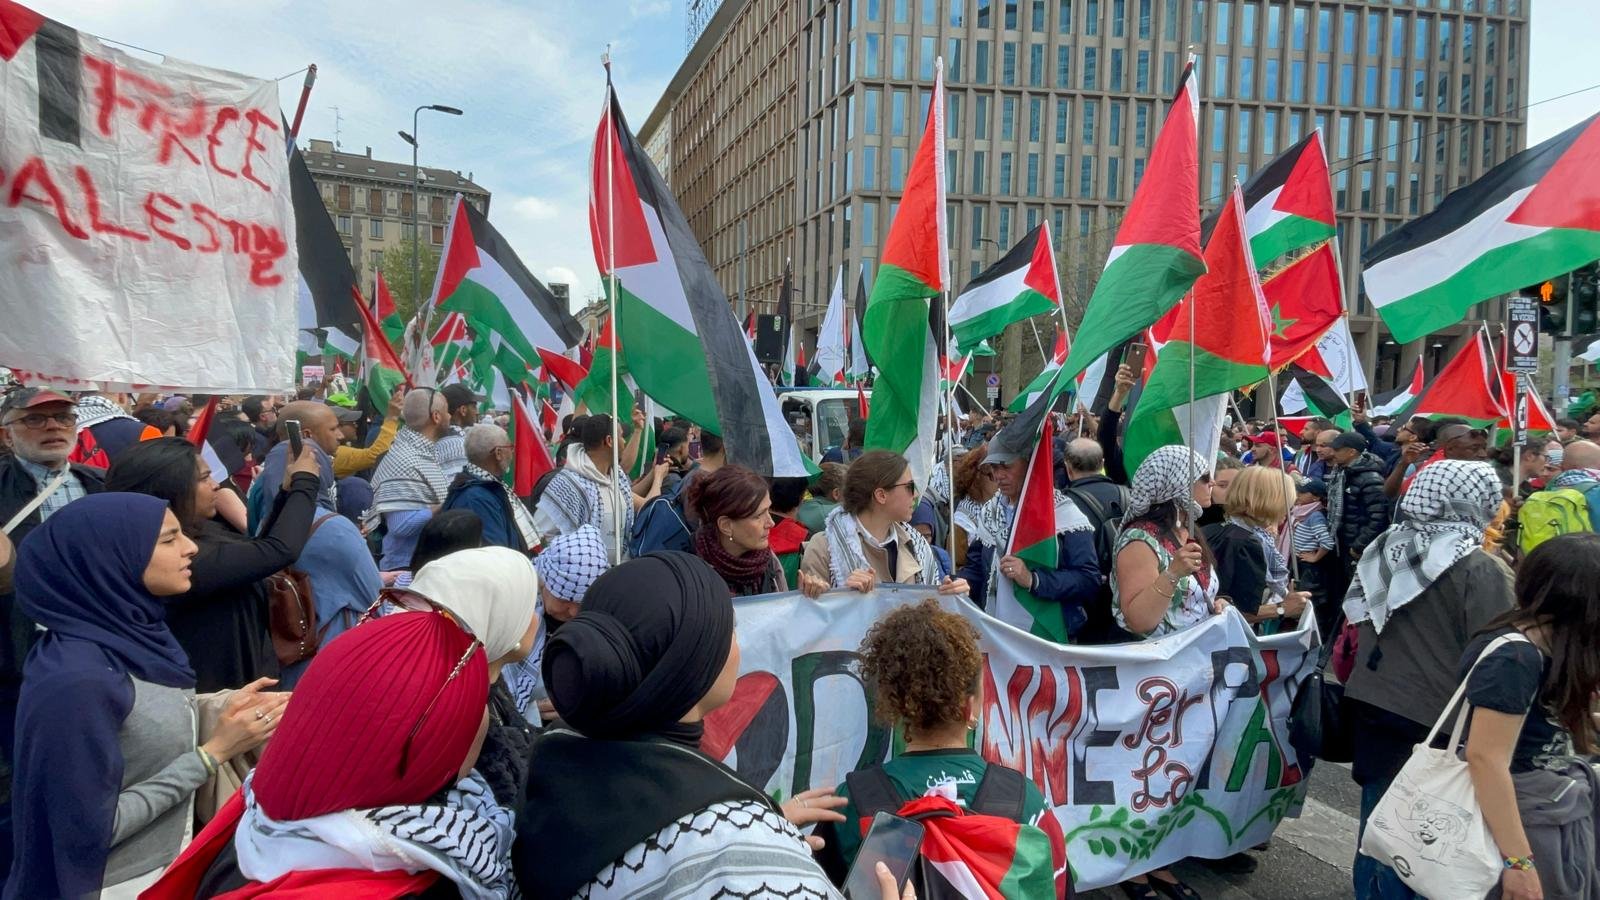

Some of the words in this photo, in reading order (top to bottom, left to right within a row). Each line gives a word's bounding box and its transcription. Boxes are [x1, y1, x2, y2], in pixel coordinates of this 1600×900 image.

[84, 54, 279, 192] FREE
[0, 156, 288, 287] ALESTINE
[792, 650, 1120, 808] DNNE
